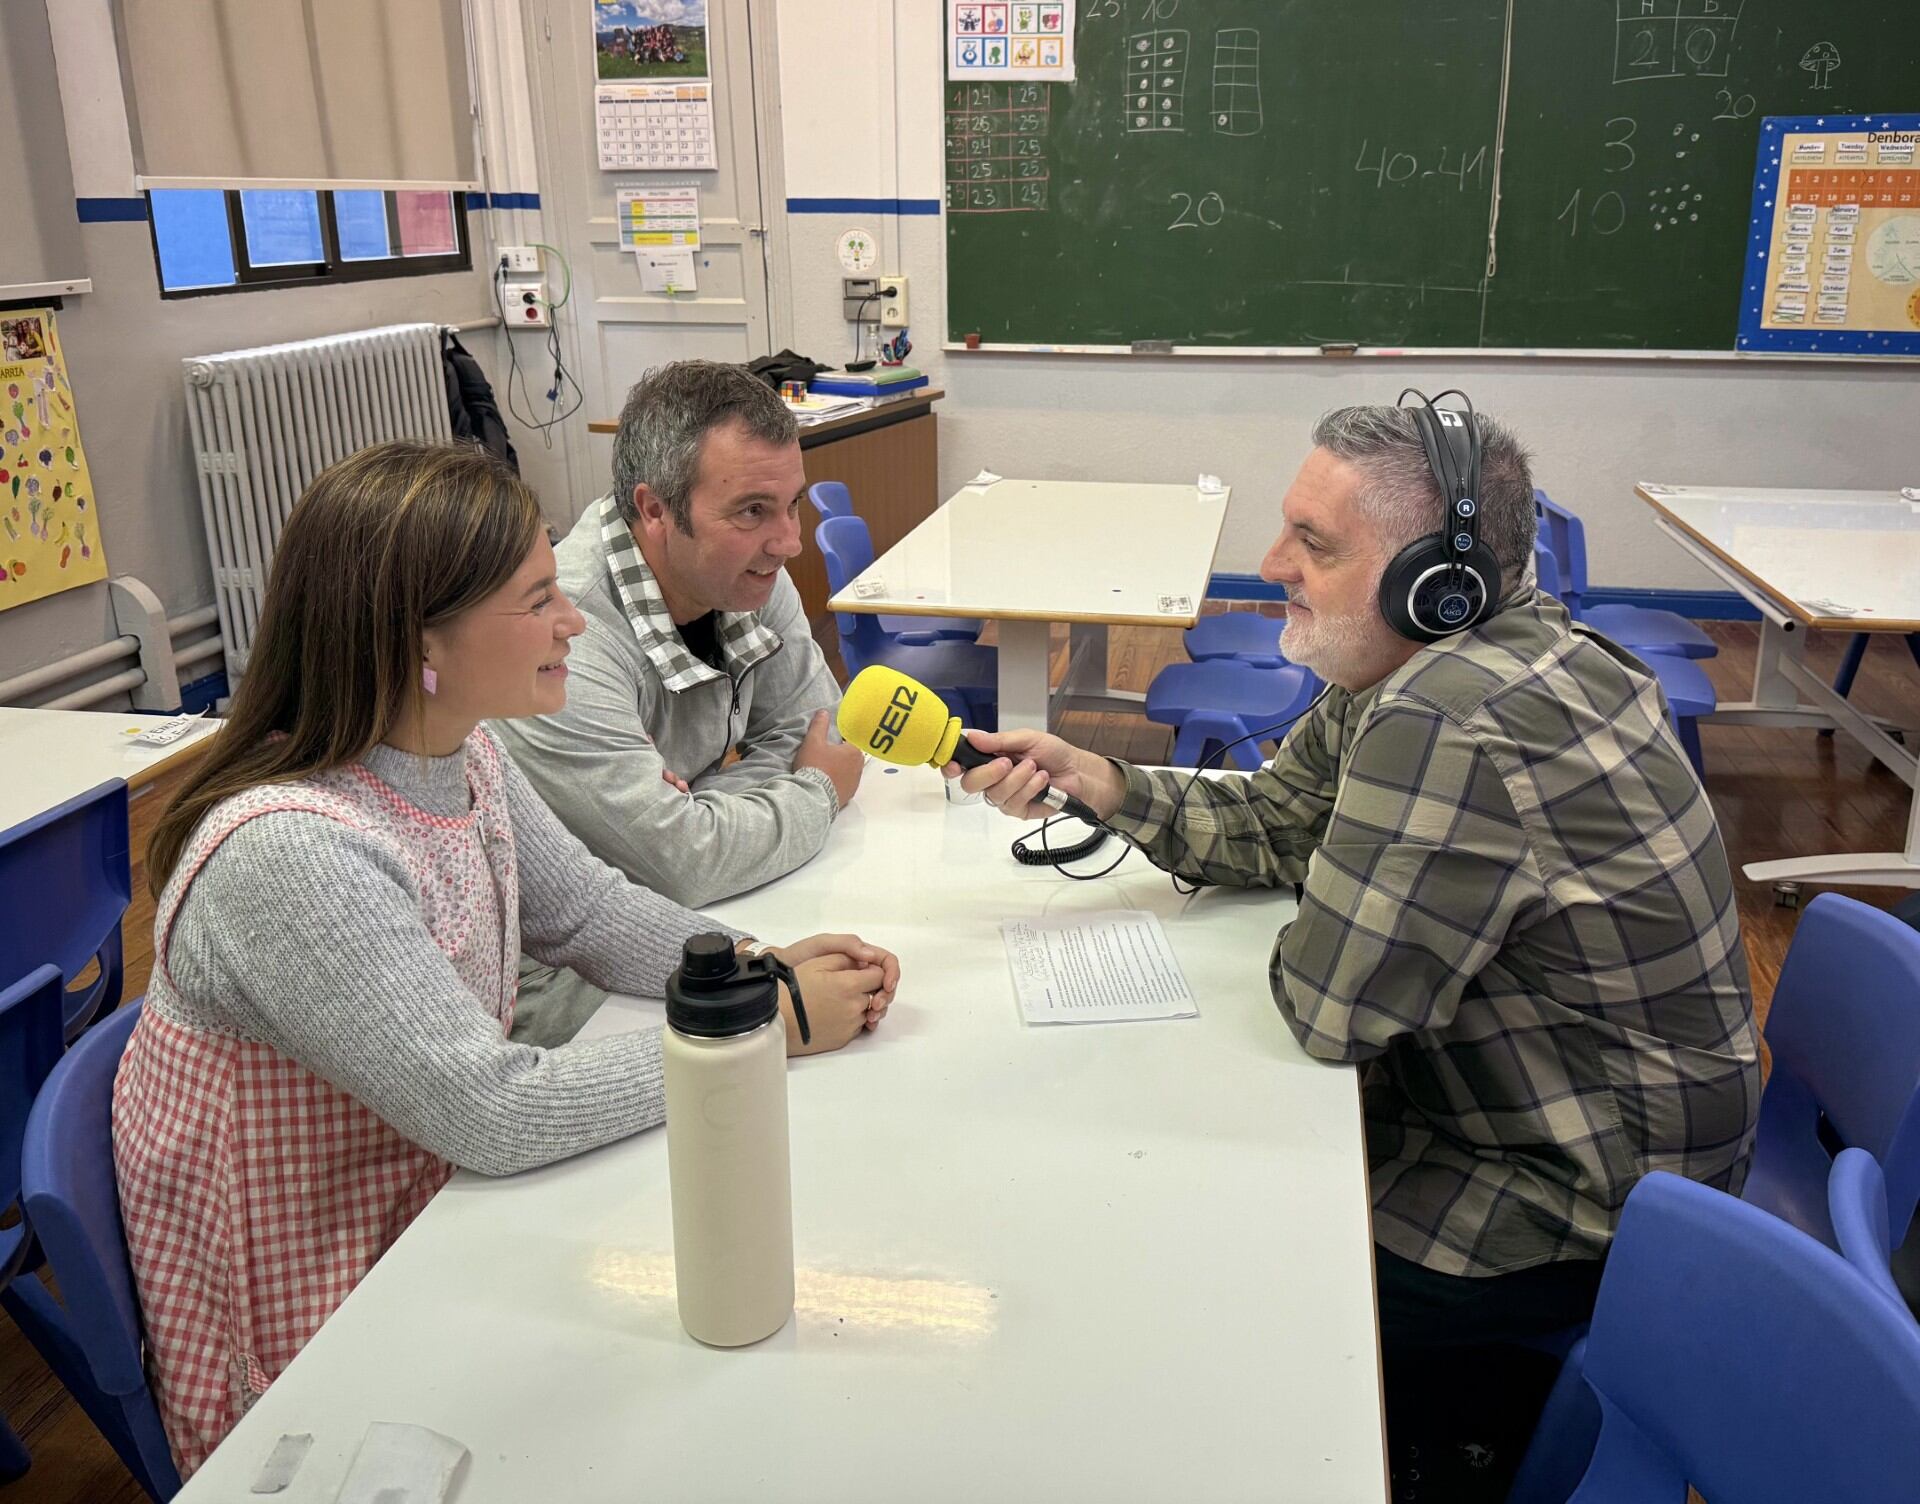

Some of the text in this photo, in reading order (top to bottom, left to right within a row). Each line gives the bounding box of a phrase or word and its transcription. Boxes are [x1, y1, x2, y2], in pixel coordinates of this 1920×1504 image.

[1629, 30, 1661, 66] 2
[973, 87, 991, 106] 24
[1020, 86, 1038, 103] 25
[1712, 90, 1756, 121] 20
[1018, 139, 1041, 156] 25
[1604, 117, 1637, 173] 3
[1867, 131, 1920, 145] Denbora
[971, 163, 992, 179] 25
[1020, 160, 1040, 177] 25
[1795, 175, 1911, 183] 1 2 3 4 5 6 7
[972, 189, 996, 206] 23
[1021, 183, 1041, 204] 25
[1167, 192, 1225, 231] 20
[1558, 188, 1626, 237] 10
[1443, 608, 1462, 616] AKG
